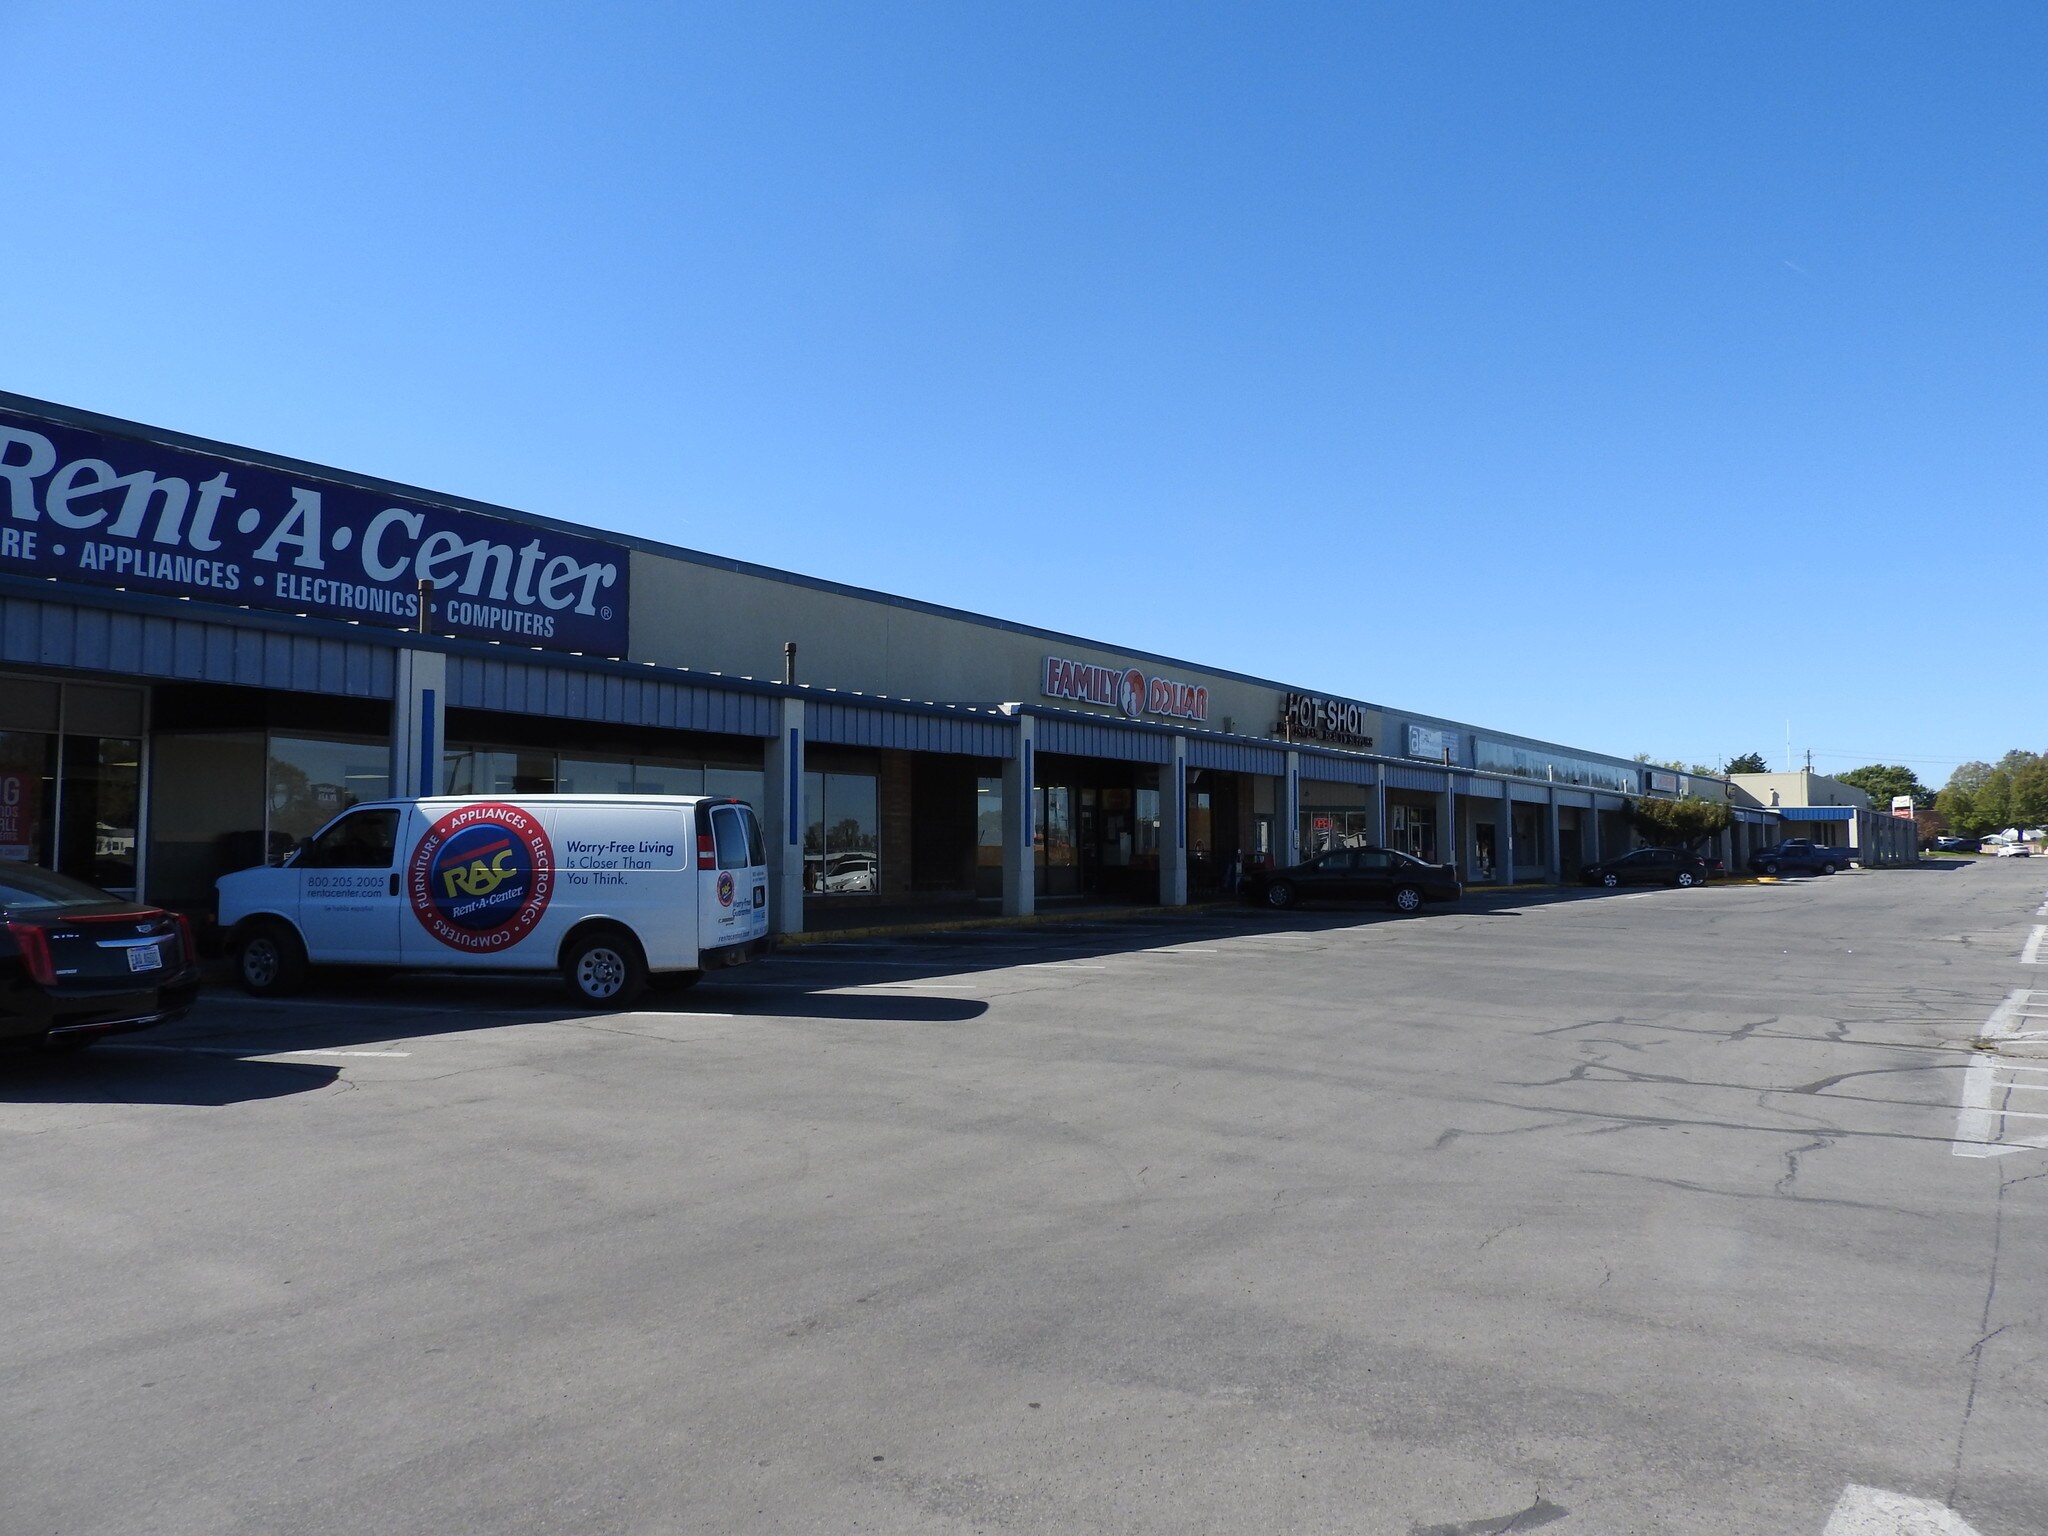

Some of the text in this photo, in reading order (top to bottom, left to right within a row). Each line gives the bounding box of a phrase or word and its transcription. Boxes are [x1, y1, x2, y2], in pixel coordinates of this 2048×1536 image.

[80, 542, 240, 590] APPLIANCES
[276, 572, 418, 617] ELECTRONICS
[447, 600, 554, 638] COMPUTERS
[1047, 657, 1208, 721] FAMILY DOLLAR
[0, 775, 20, 805] G
[451, 808, 527, 829] APPLIANCES
[566, 856, 651, 869] Is Closer Than
[567, 841, 674, 857] Worry-Free Living
[308, 877, 385, 888] 800.205.2005
[415, 835, 440, 909] FURNITURE
[443, 849, 517, 898] RAC
[521, 836, 549, 925] ELECTRONICS
[567, 872, 628, 885] You Think.
[307, 889, 382, 898] rentacenter.com
[434, 920, 511, 947] COMPUTERS
